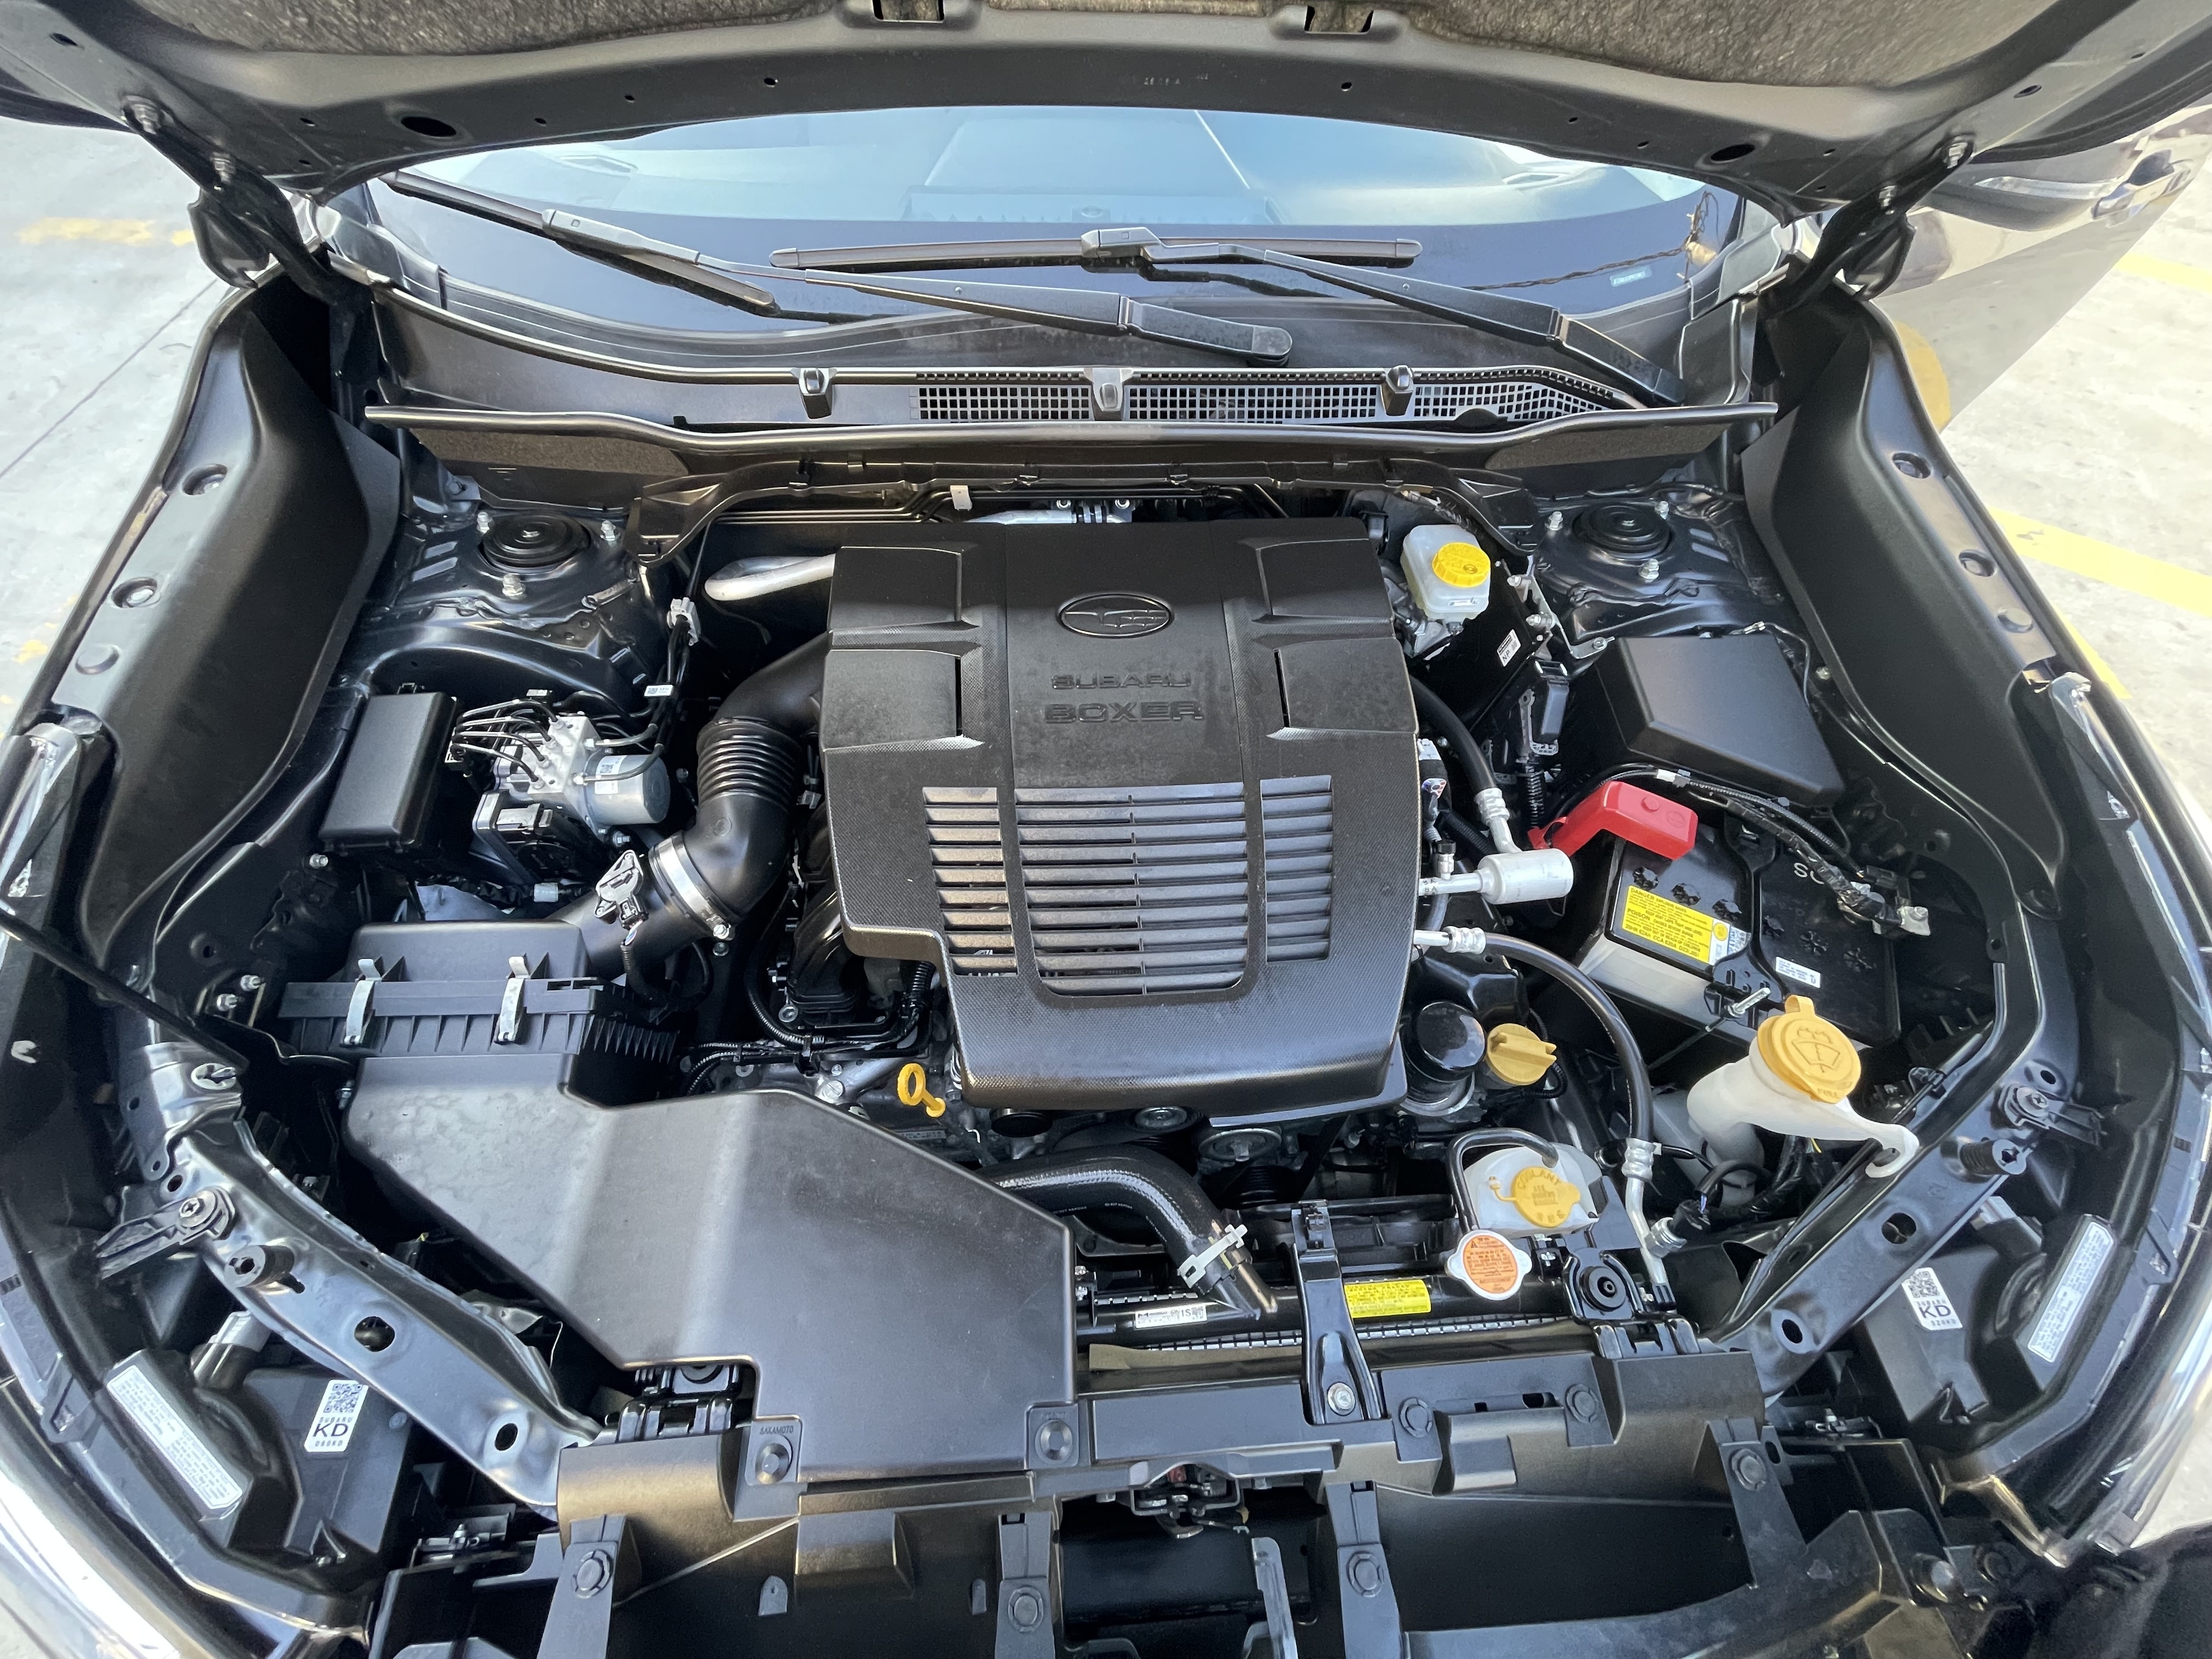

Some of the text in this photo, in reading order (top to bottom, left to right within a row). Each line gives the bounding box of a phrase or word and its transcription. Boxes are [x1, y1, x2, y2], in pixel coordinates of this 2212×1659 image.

[1502, 650, 1510, 662] NP
[1051, 674, 1191, 690] SUBARU
[1045, 702, 1203, 723] BOXER
[1631, 888, 1655, 901] DANGER
[1628, 908, 1650, 921] POISON
[1653, 934, 1664, 943] CCA
[1517, 1169, 1562, 1189] COOLANT
[1919, 1305, 1951, 1318] KD
[313, 1423, 348, 1437] KD
